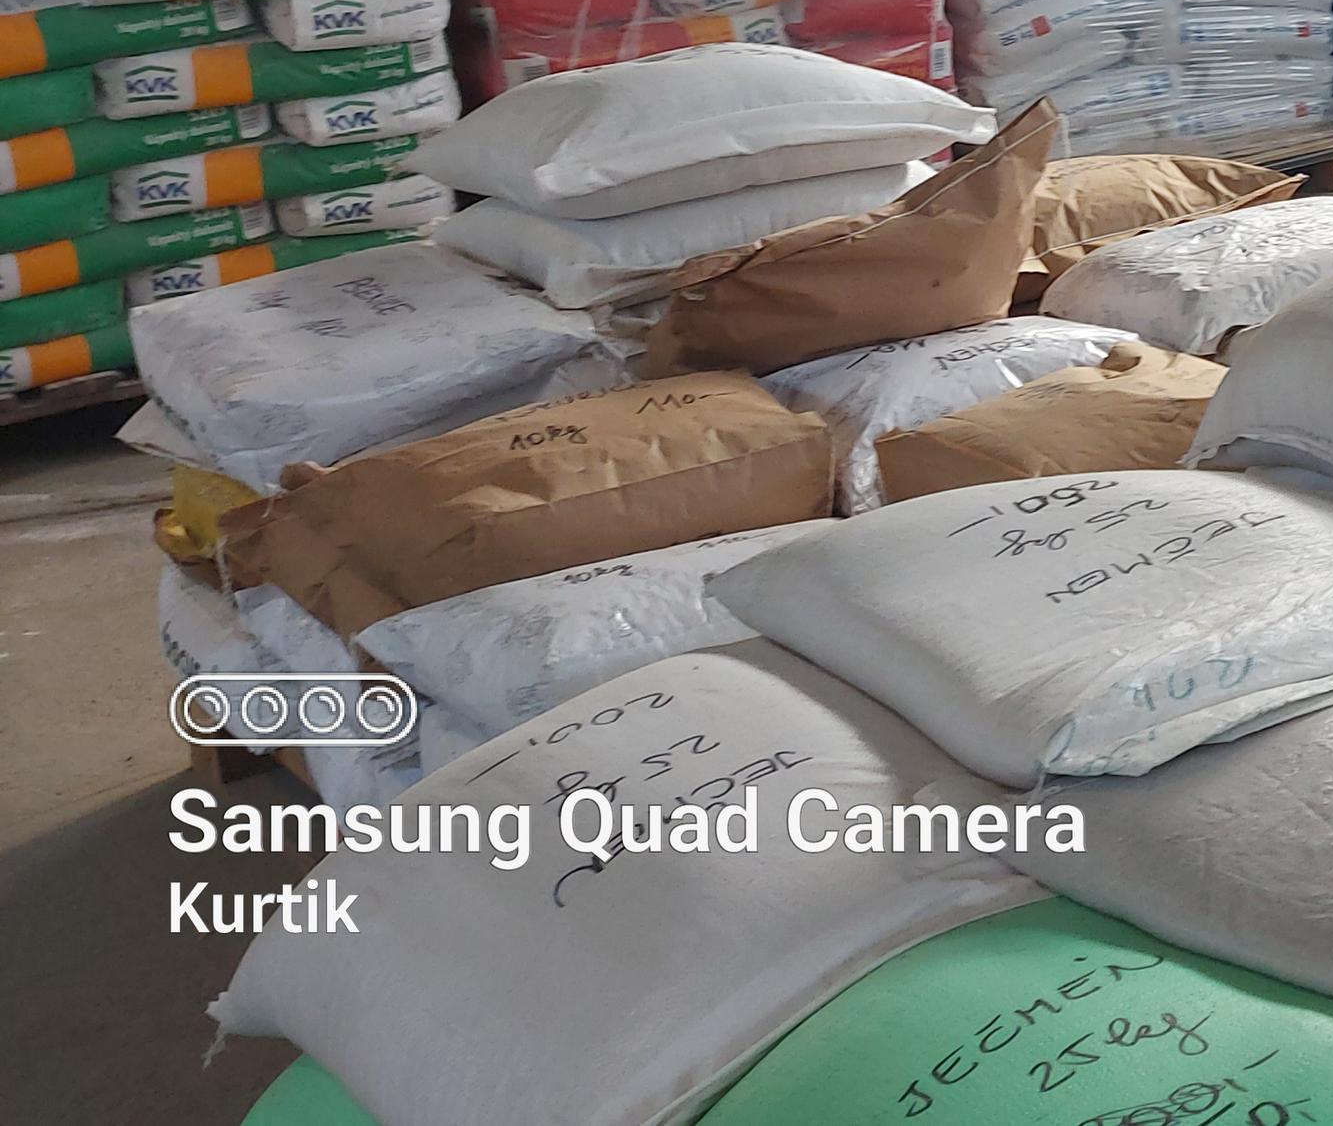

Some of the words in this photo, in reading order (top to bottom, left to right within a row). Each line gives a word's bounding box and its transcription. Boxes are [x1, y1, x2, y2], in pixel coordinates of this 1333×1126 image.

[314, 10, 366, 31] KVK
[126, 75, 178, 93] KVK
[326, 109, 378, 132] KVK
[138, 181, 190, 200] KVK
[324, 201, 373, 222] KVK
[154, 273, 204, 292] KVK
